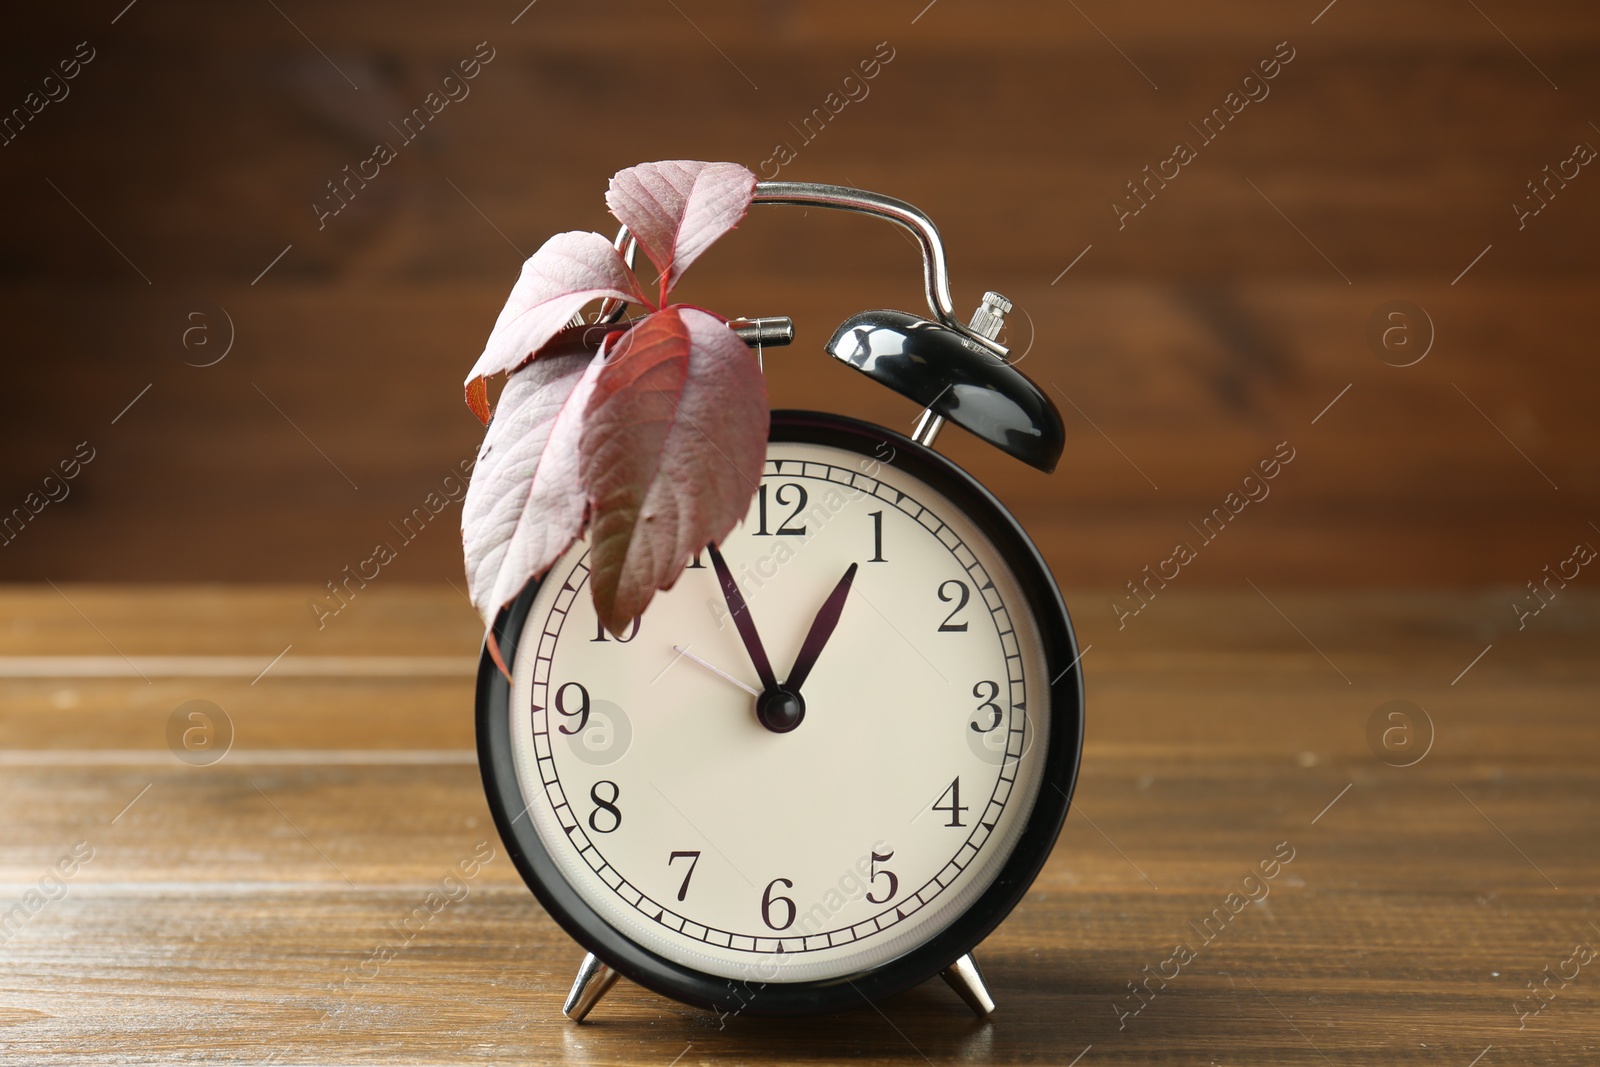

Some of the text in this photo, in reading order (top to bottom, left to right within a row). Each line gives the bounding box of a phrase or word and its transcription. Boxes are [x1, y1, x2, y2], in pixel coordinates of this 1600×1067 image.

[752, 483, 808, 536] 12
[867, 510, 889, 562] 1
[937, 579, 970, 632] 2
[554, 681, 590, 735] 9
[970, 680, 1003, 733] 3
[589, 780, 621, 833] 8
[932, 775, 969, 827] 4
[668, 850, 701, 902] 7
[865, 850, 899, 904] 5
[761, 877, 797, 931] 6
